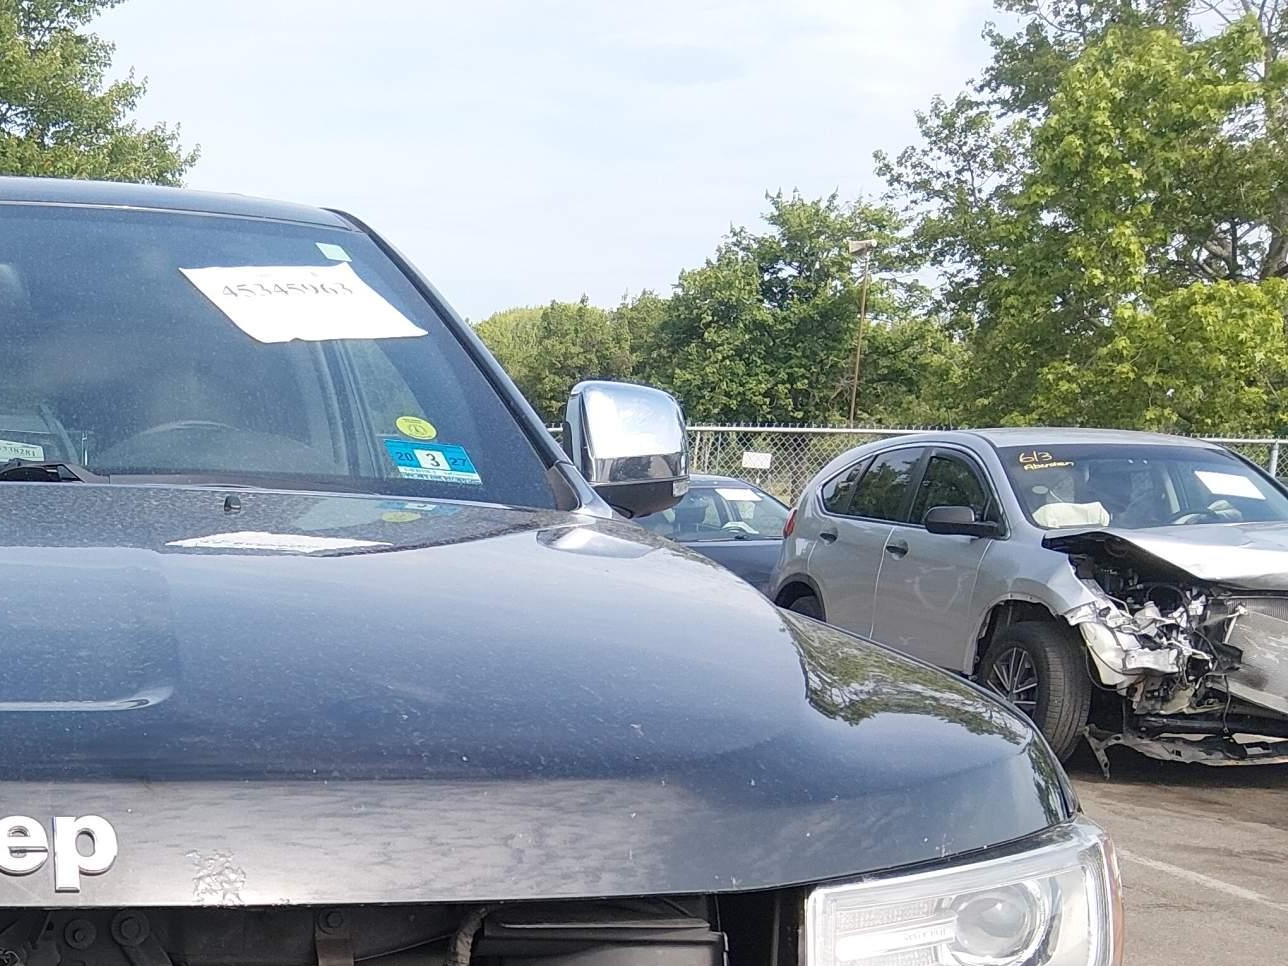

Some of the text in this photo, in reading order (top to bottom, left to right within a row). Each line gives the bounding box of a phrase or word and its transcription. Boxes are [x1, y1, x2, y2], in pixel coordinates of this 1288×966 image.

[222, 282, 354, 298] 45345963
[395, 451, 414, 462] 20
[425, 452, 441, 467] 3
